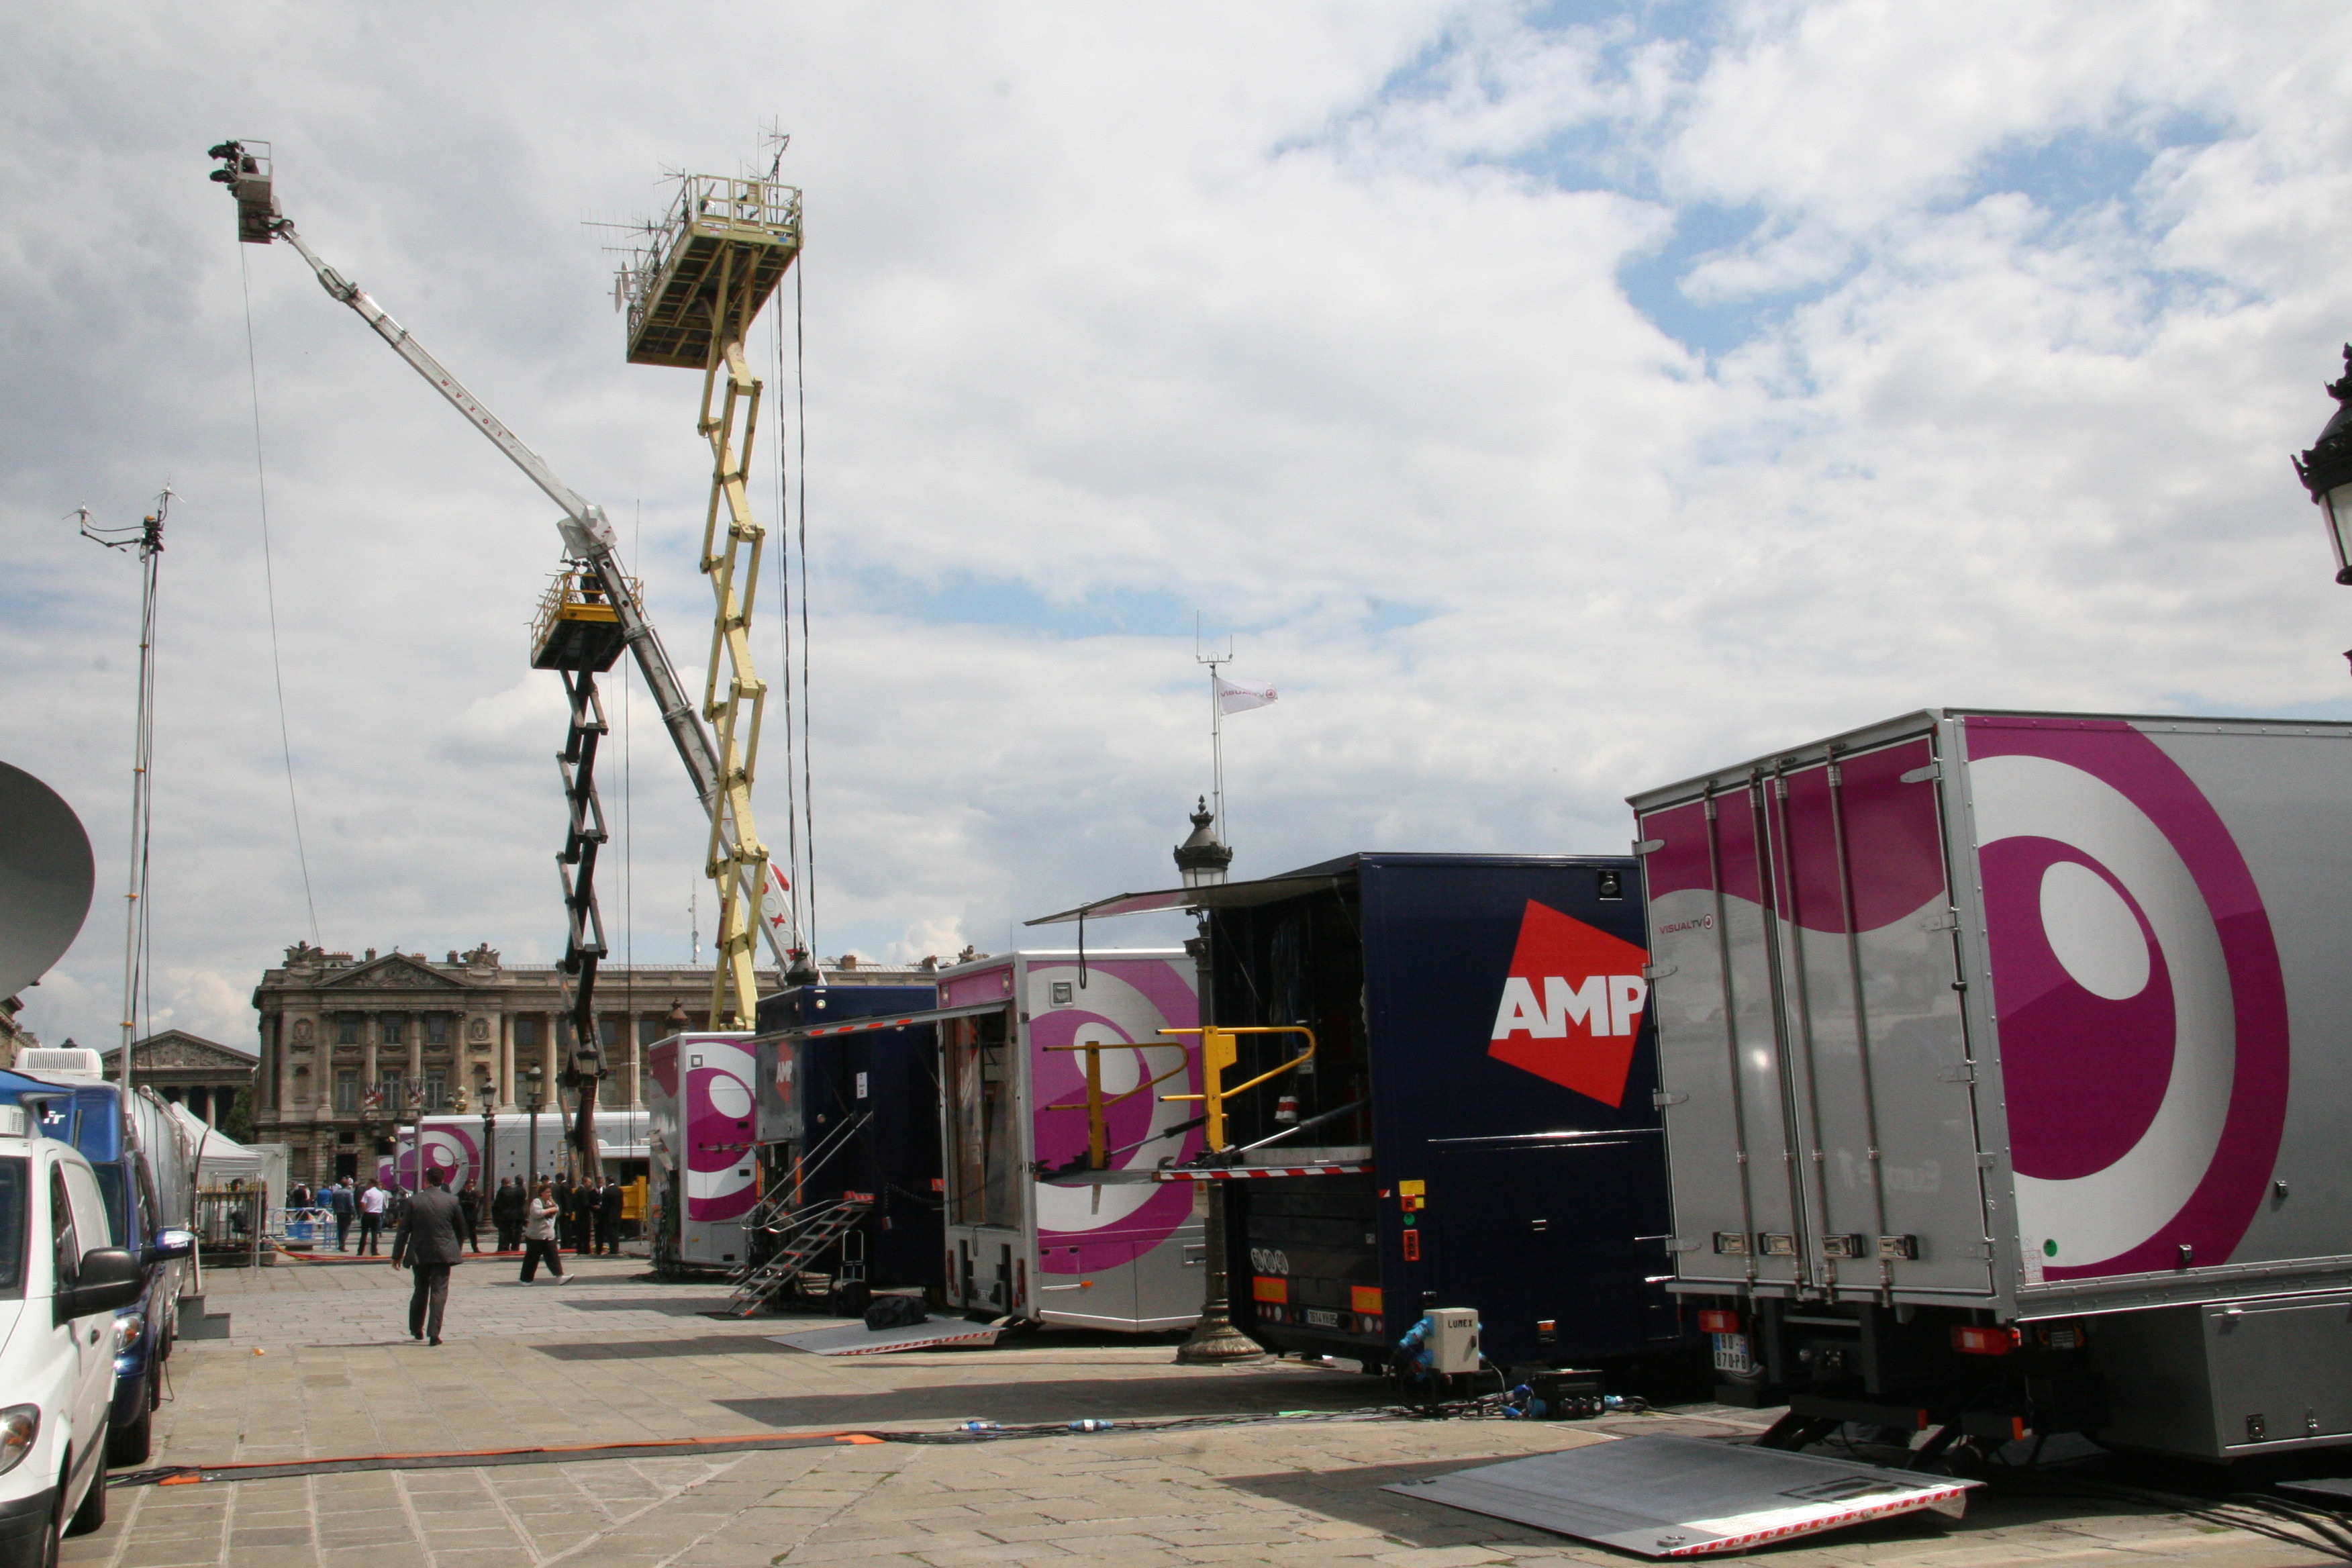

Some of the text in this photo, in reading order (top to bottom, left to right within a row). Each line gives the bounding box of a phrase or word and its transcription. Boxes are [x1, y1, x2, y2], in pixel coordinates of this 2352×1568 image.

[1491, 975, 1649, 1040] AMP
[775, 1060, 793, 1083] AMP
[1448, 1318, 1473, 1328] LUMEX
